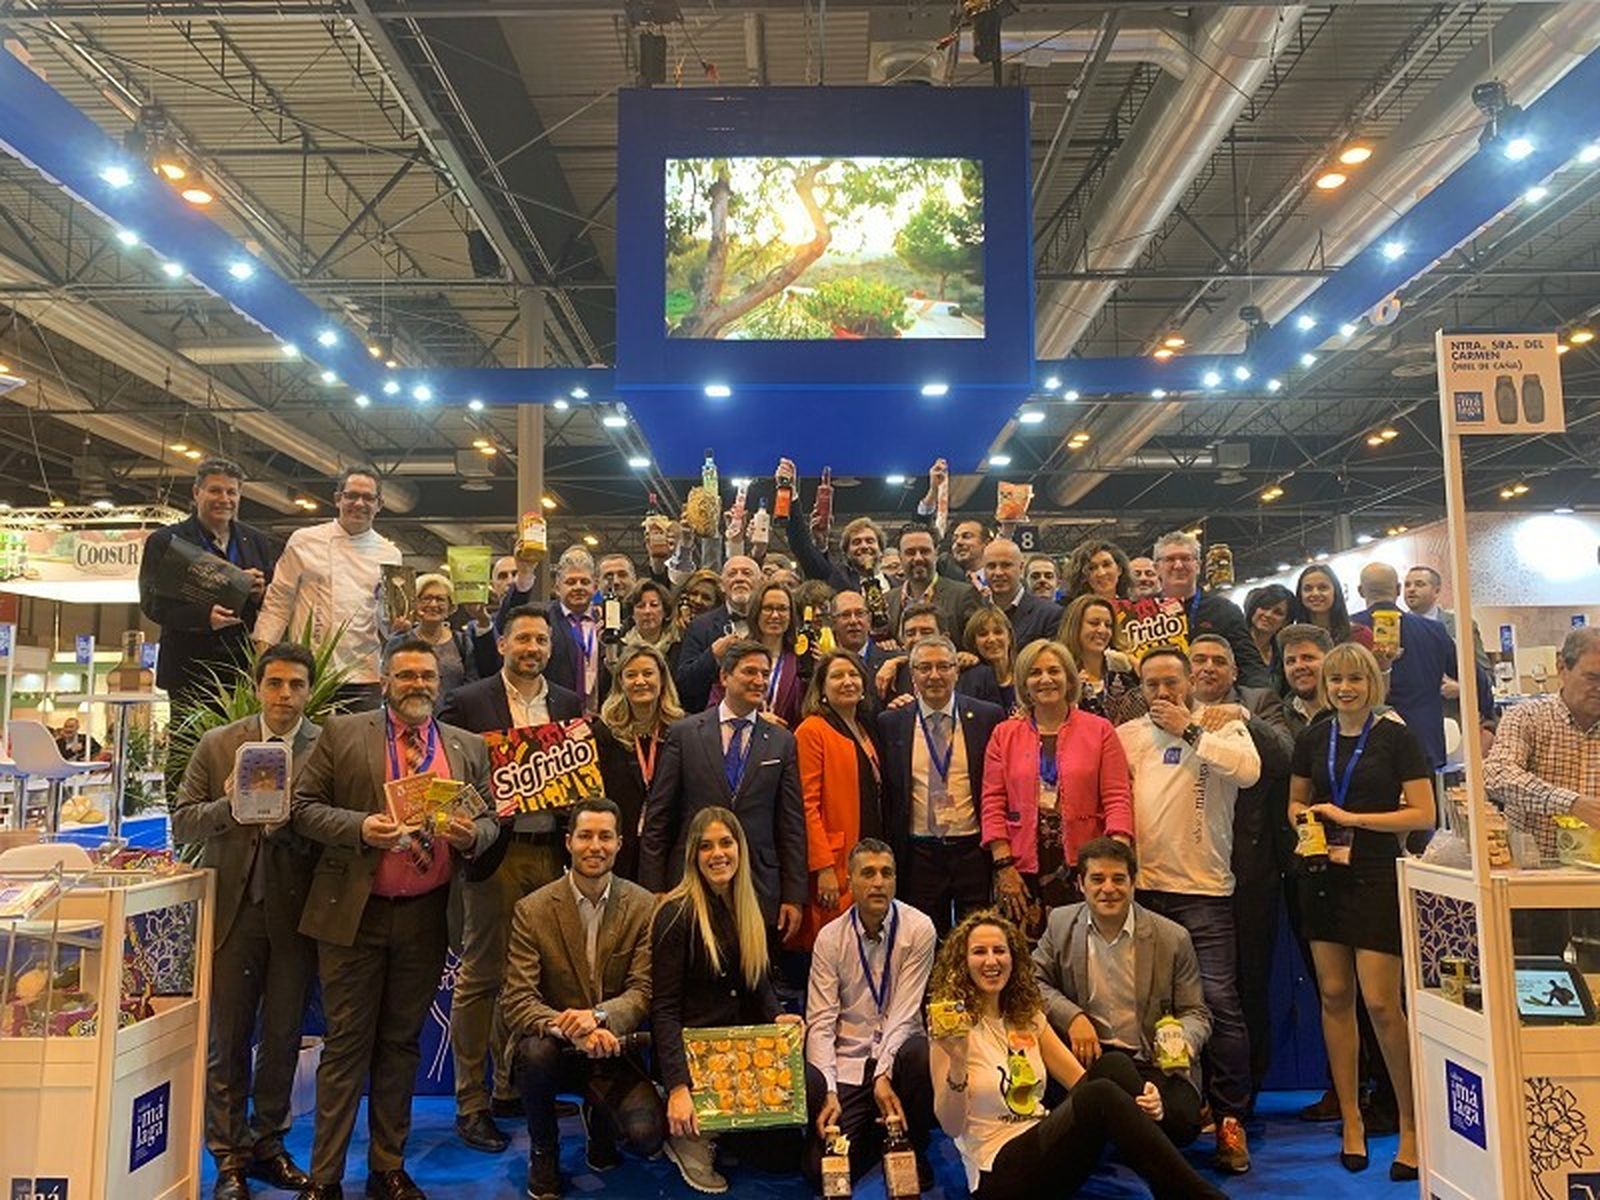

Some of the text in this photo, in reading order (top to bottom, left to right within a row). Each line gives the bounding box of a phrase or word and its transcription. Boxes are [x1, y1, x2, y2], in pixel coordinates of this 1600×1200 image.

[1451, 340, 1544, 350] NTRA. SRA. DEL
[1451, 351, 1499, 360] CARMEN
[1479, 362, 1489, 370] DE
[1021, 531, 1035, 549] 8
[495, 741, 592, 797] Sigfrido
